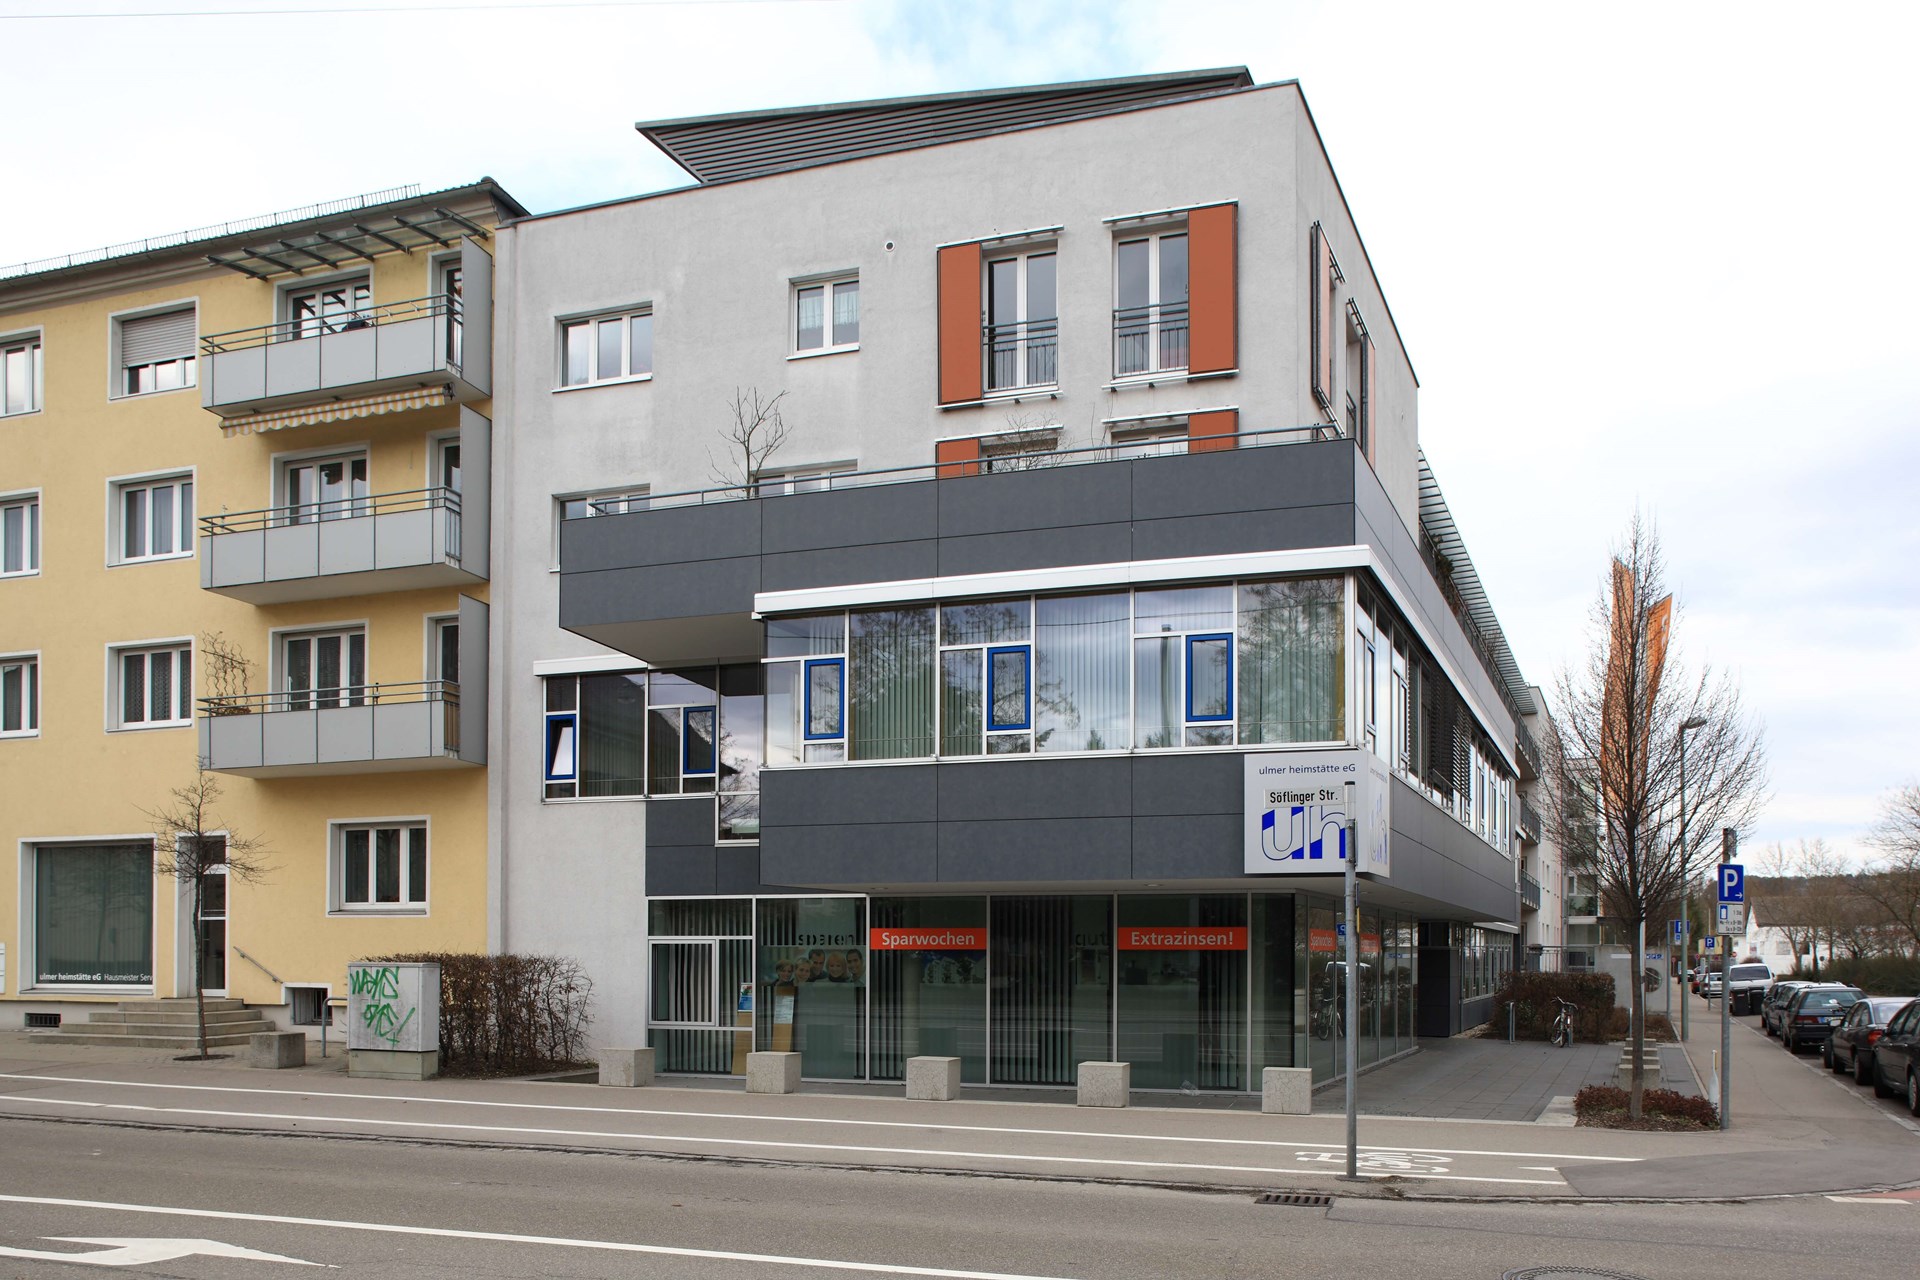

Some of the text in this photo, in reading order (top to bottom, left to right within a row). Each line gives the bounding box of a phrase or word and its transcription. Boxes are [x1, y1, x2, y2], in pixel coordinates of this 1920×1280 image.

[1259, 763, 1356, 775] ulmer heimstätte eG
[1270, 789, 1338, 804] Söflinger Str.
[1724, 869, 1738, 897] P
[881, 932, 975, 949] Sparwochen
[1130, 931, 1233, 946] Extrazinsen!
[1706, 938, 1713, 947] P
[39, 972, 57, 981] ulmer
[58, 972, 91, 981] heimstätte
[92, 973, 101, 981] eG
[104, 973, 139, 981] Hausmeister
